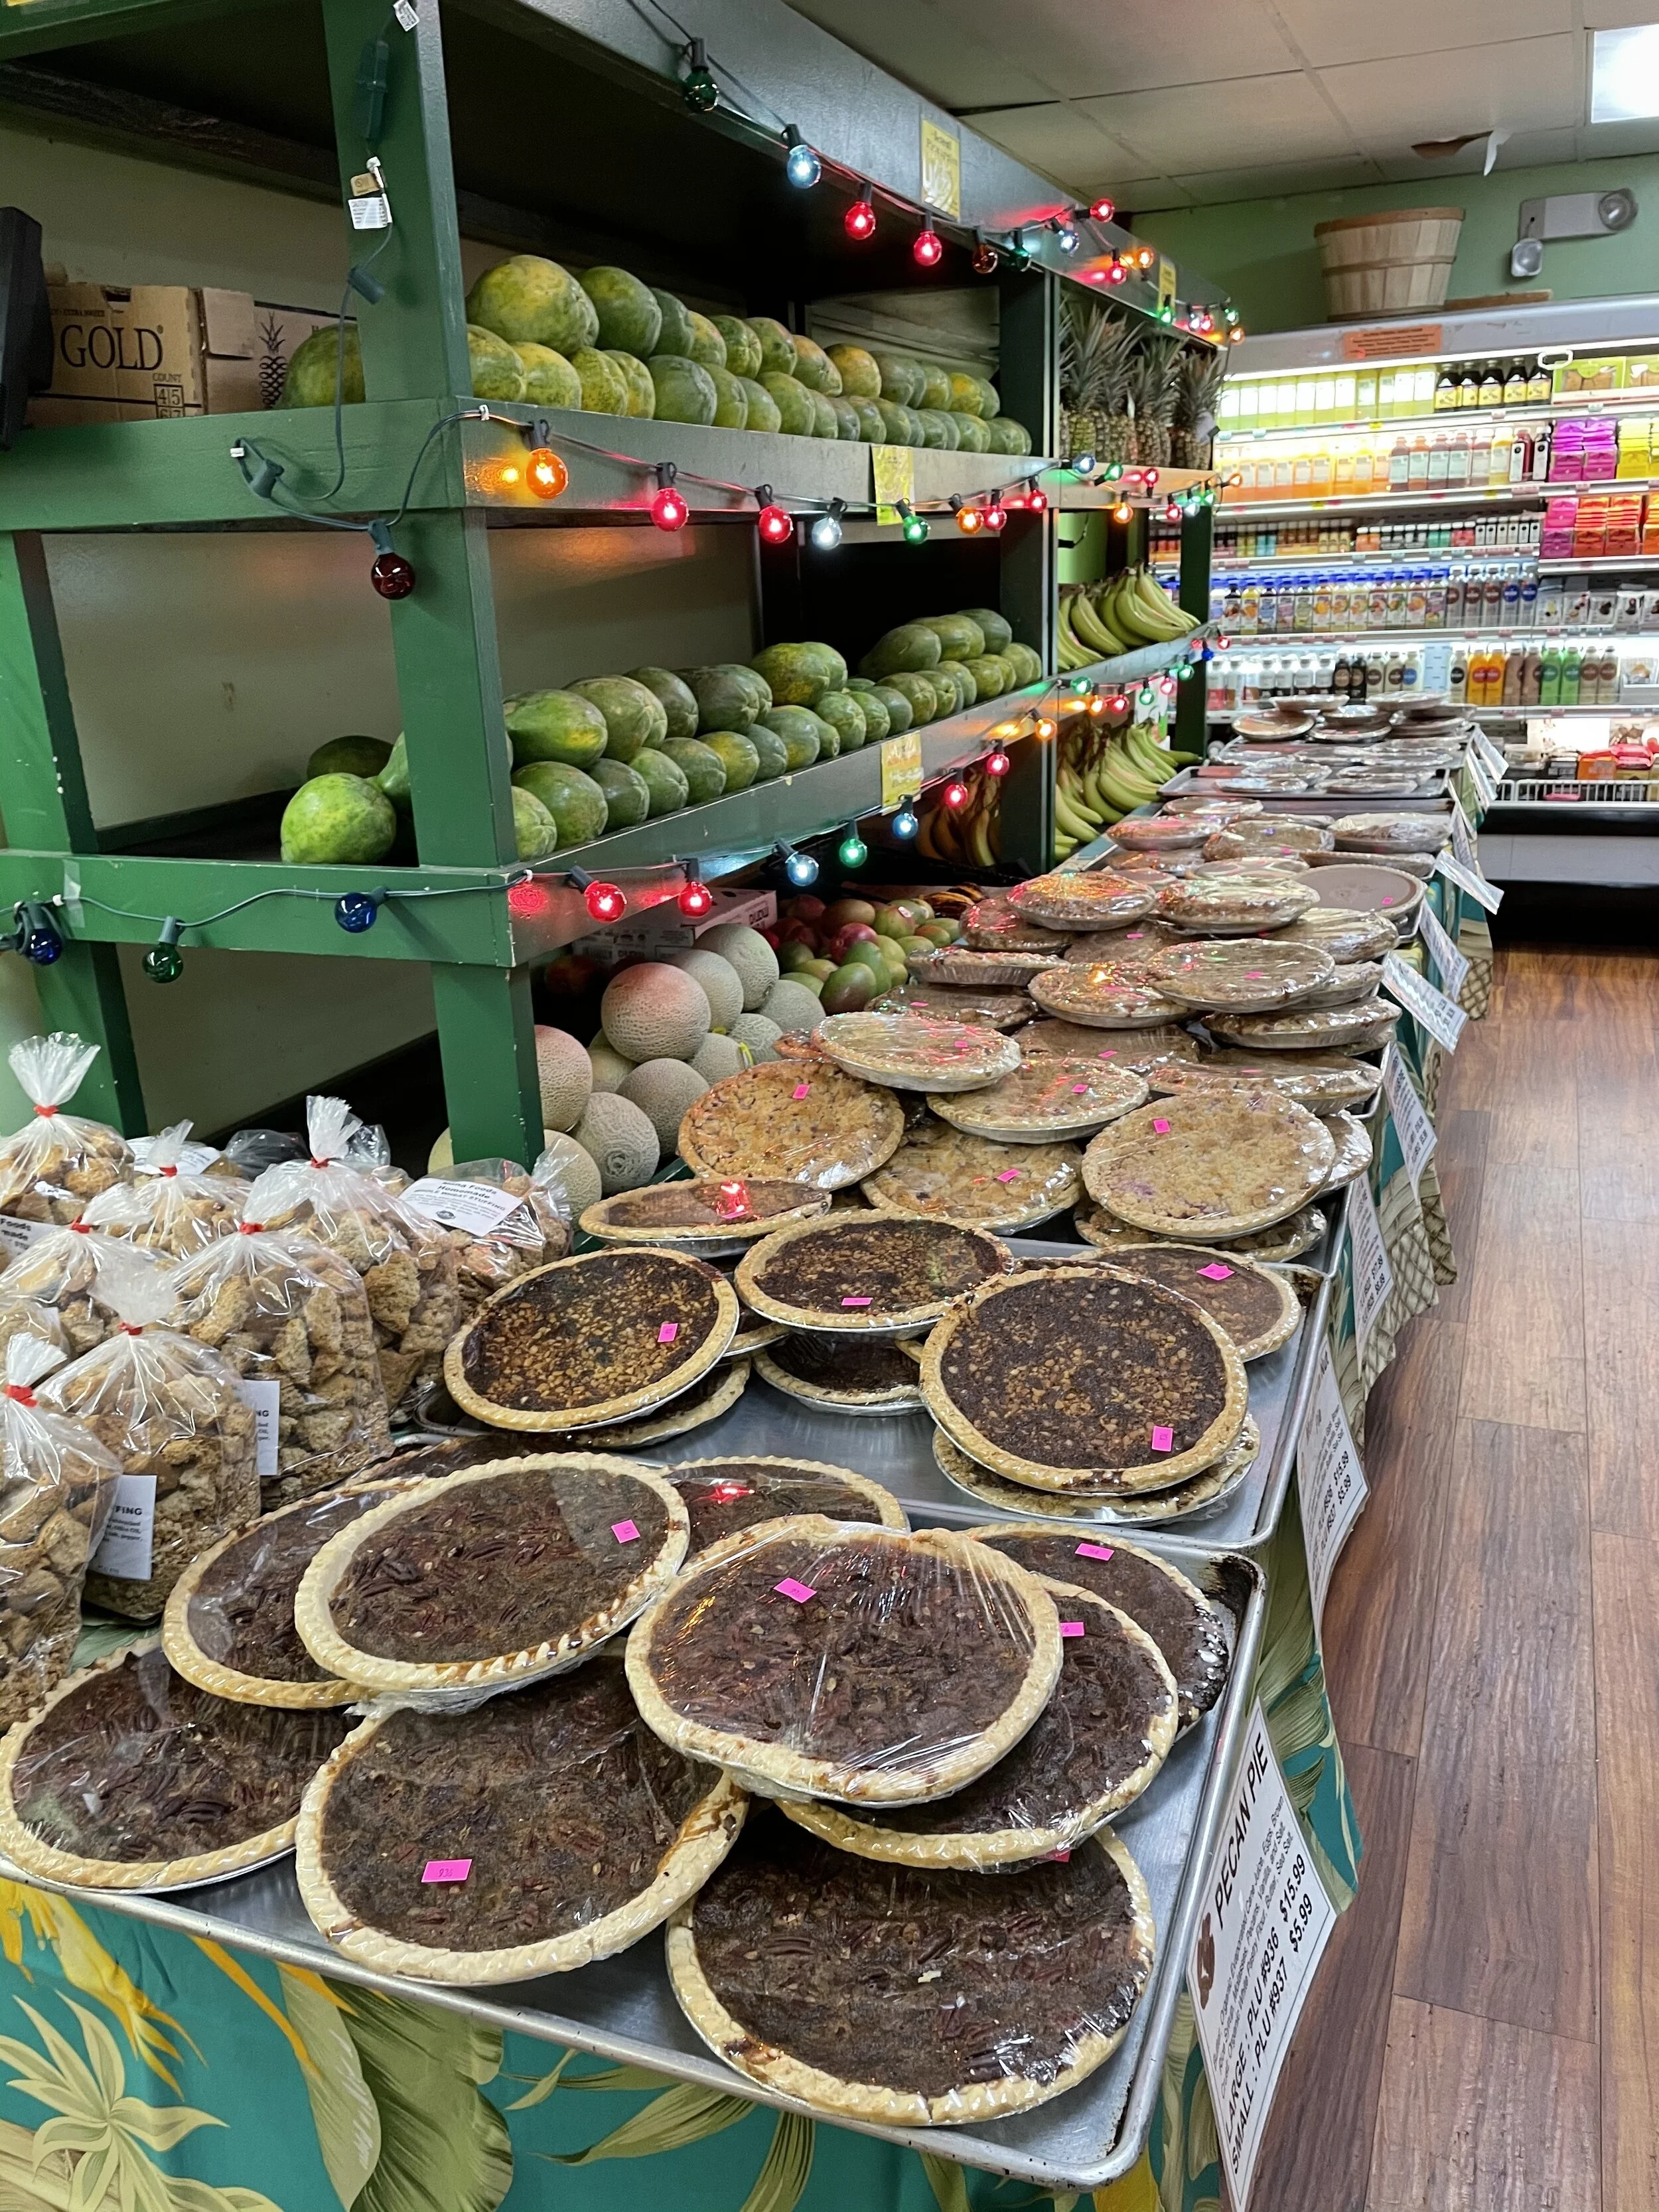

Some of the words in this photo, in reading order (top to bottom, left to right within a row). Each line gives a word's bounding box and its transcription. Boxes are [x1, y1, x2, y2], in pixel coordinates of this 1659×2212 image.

[60, 325, 163, 370] GOLD
[153, 373, 182, 382] COUNT
[437, 1185, 490, 1199] Homemade
[469, 1185, 497, 1195] Foods
[115, 1506, 143, 1515] FING
[1215, 1791, 1250, 1929] PECAN
[1247, 1732, 1267, 1803] PIE
[439, 1868, 453, 1878] 936
[1245, 1884, 1254, 1913] Cane
[1271, 1795, 1283, 1827] Brown
[1238, 1975, 1248, 2010] White
[1246, 1938, 1258, 1976] Pastry
[1275, 1853, 1285, 1874] Sea
[1226, 2042, 1246, 2143] LARGE
[1247, 1977, 1262, 2035] PLU
[1260, 1927, 1278, 1986] #936
[1279, 1854, 1305, 1922] $15.99
[1232, 2086, 1254, 2174] SMALL
[1254, 2009, 1270, 2068] PLU
[1269, 1956, 1287, 2018] #937
[1289, 1893, 1312, 1952] $5.99
